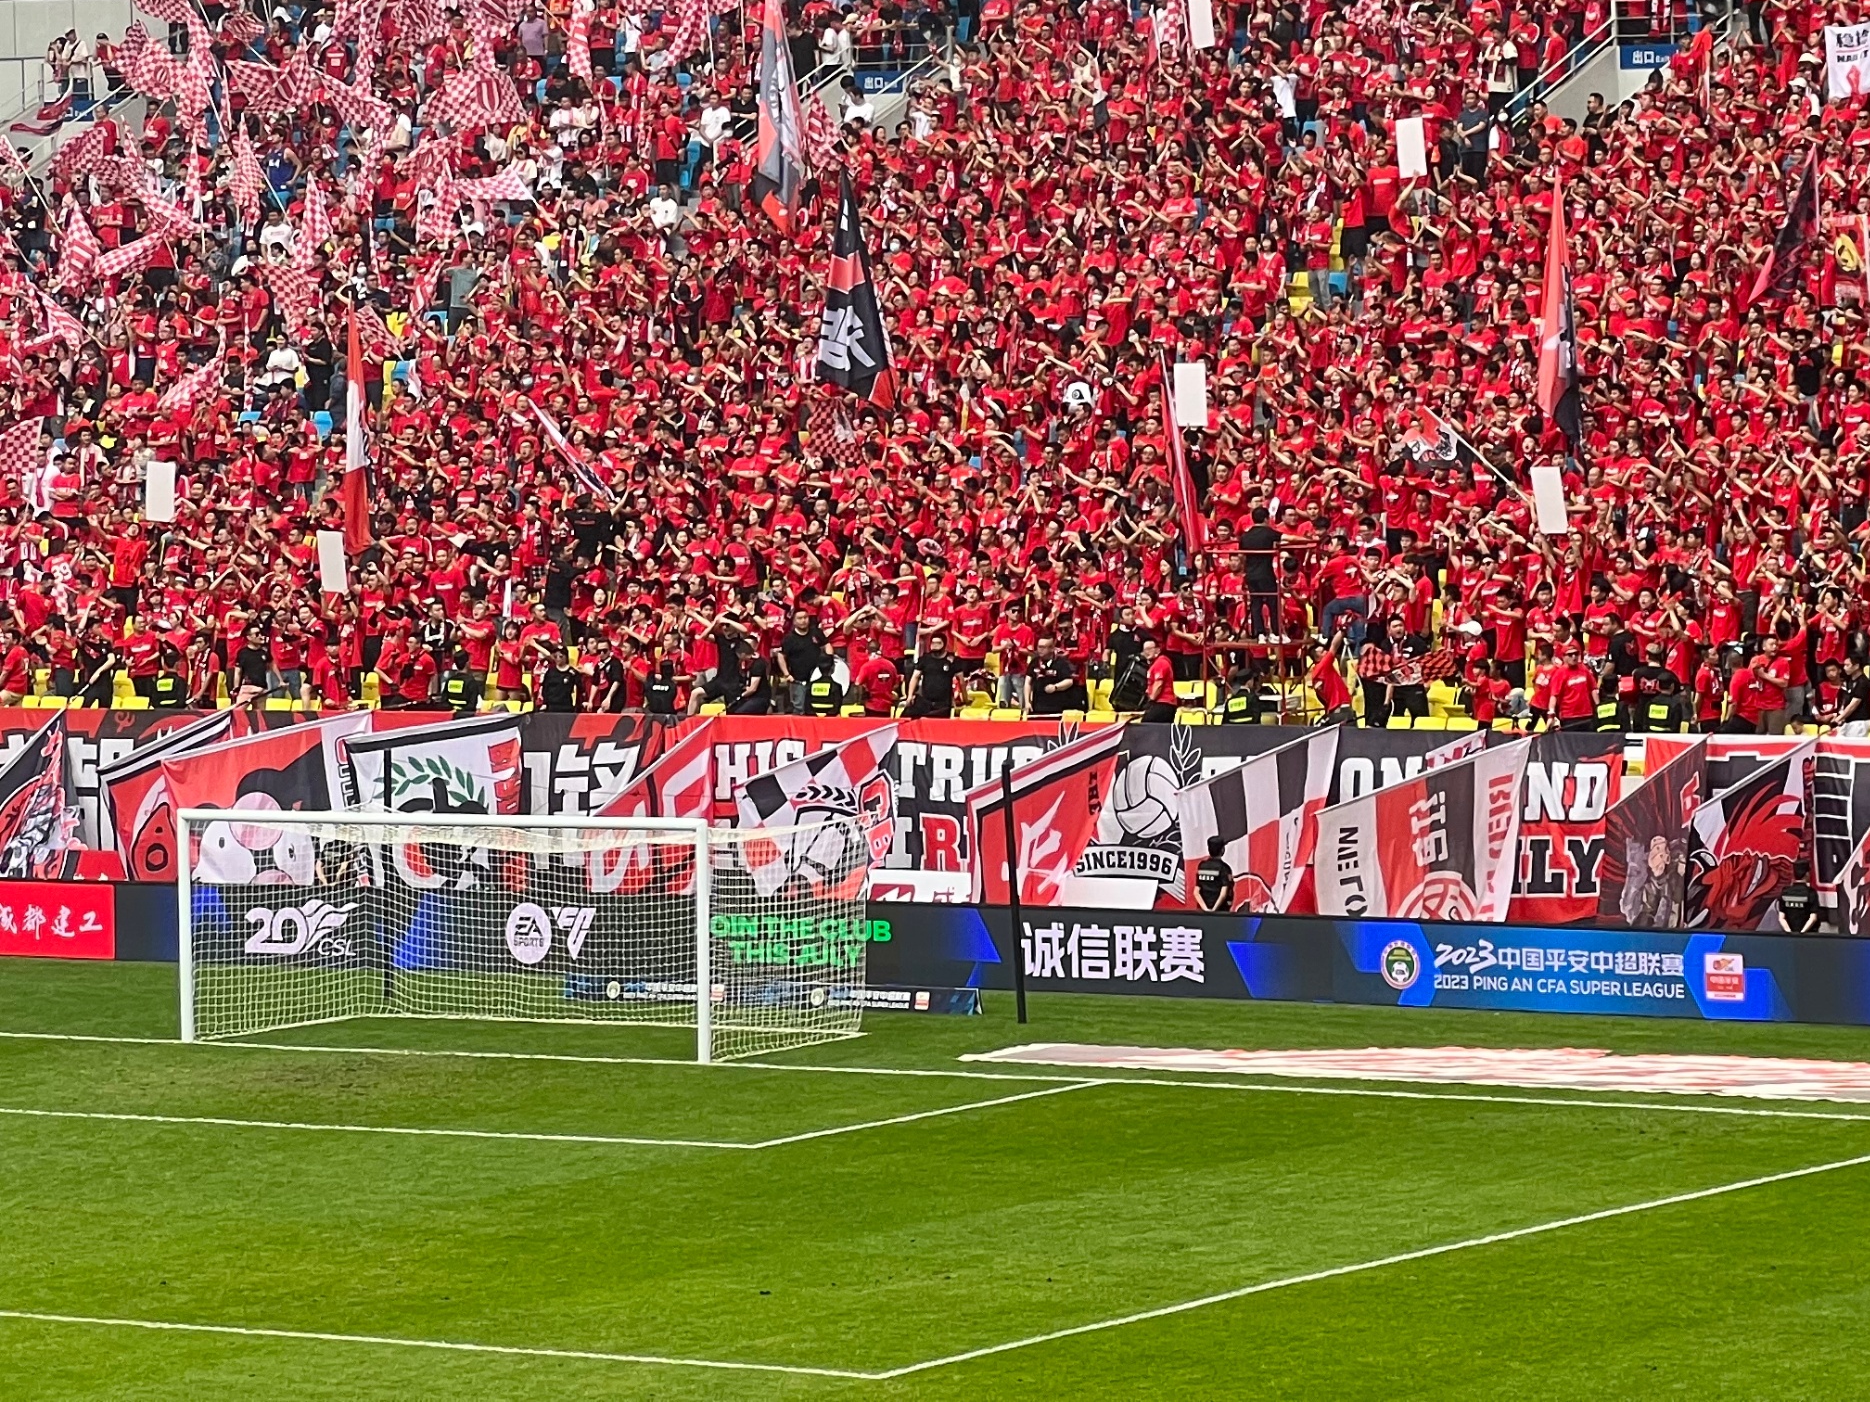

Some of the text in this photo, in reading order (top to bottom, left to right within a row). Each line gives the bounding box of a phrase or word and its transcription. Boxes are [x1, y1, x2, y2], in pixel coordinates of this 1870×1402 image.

[1632, 50, 1655, 64] 出口
[864, 76, 884, 90] 出口
[709, 914, 892, 942] OIN THE CLUB
[317, 937, 357, 957] CSL
[728, 941, 790, 965] THIS
[1020, 923, 1206, 985] 诚信联赛
[1433, 975, 1685, 1000] 2023 PING AN CFA SUPER LEAGUE
